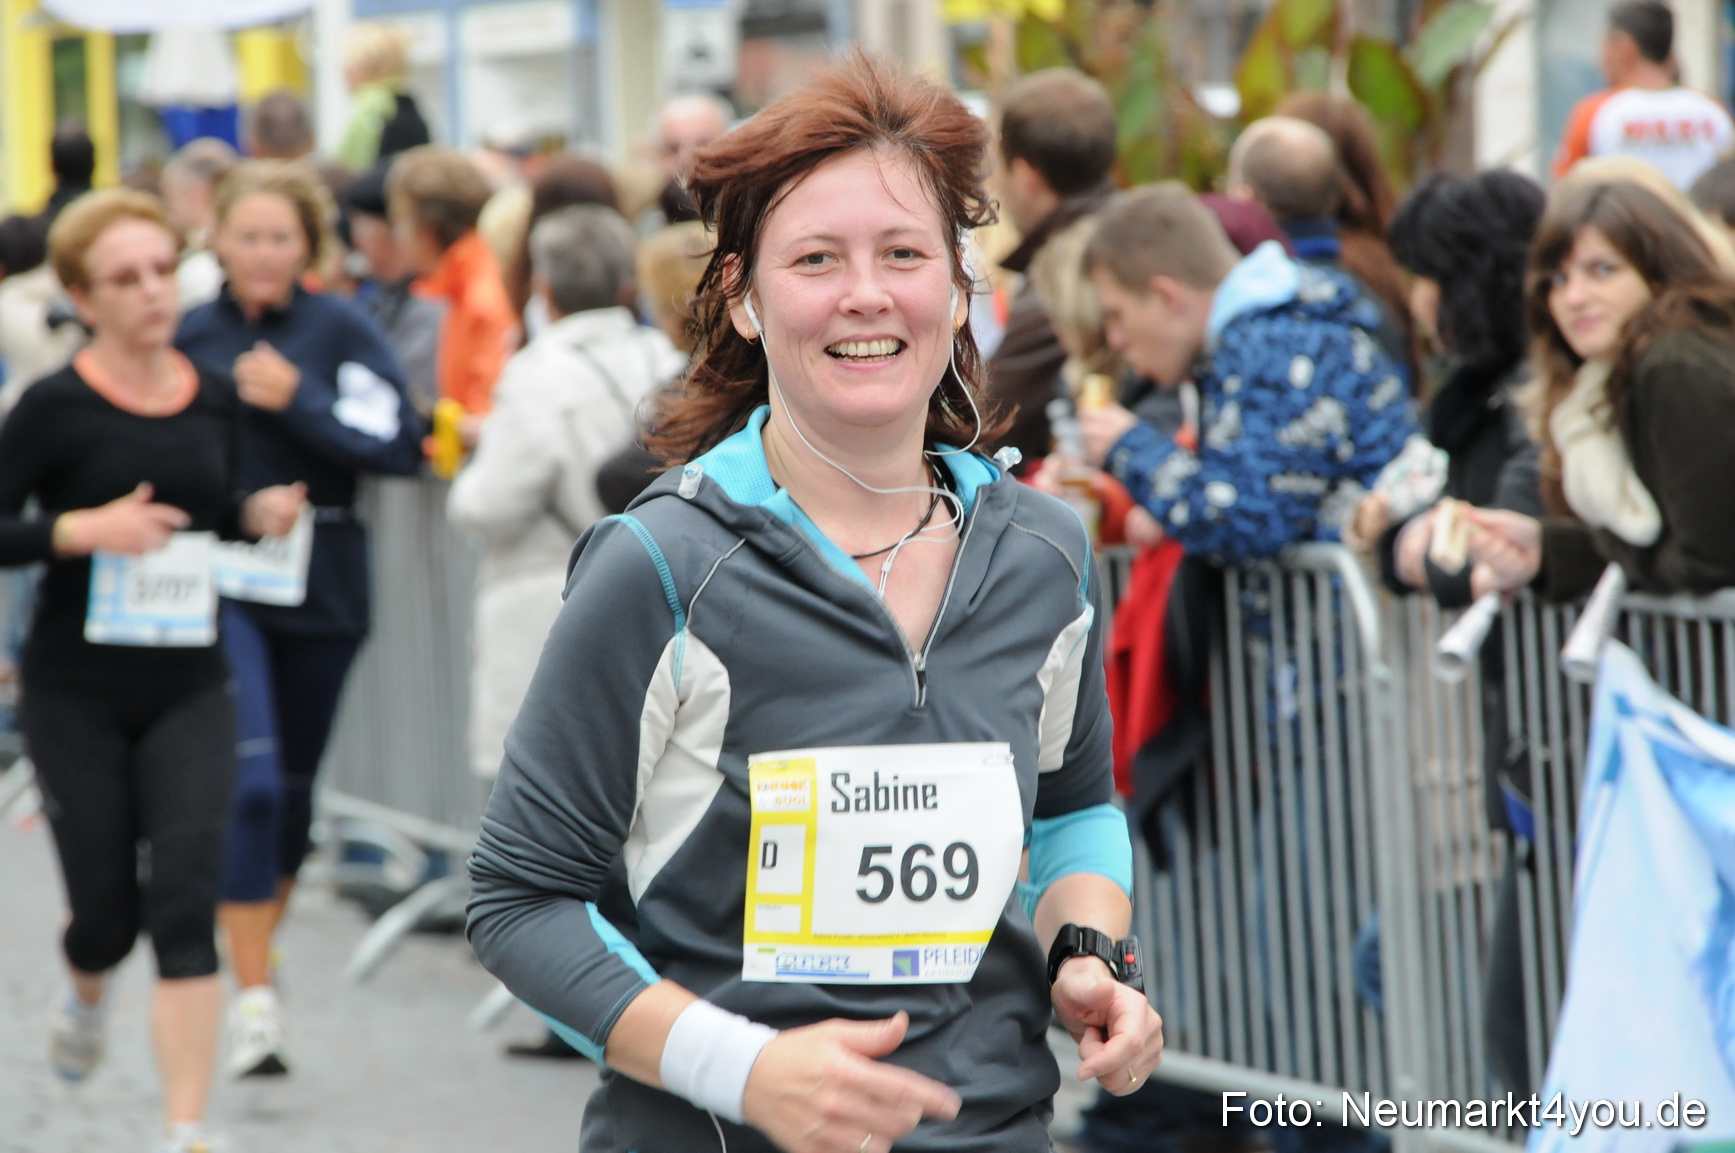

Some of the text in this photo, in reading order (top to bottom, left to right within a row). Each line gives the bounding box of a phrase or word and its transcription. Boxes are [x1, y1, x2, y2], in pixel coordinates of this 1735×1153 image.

[831, 771, 938, 813] Sabine
[761, 842, 778, 869] D
[856, 841, 979, 904] 569
